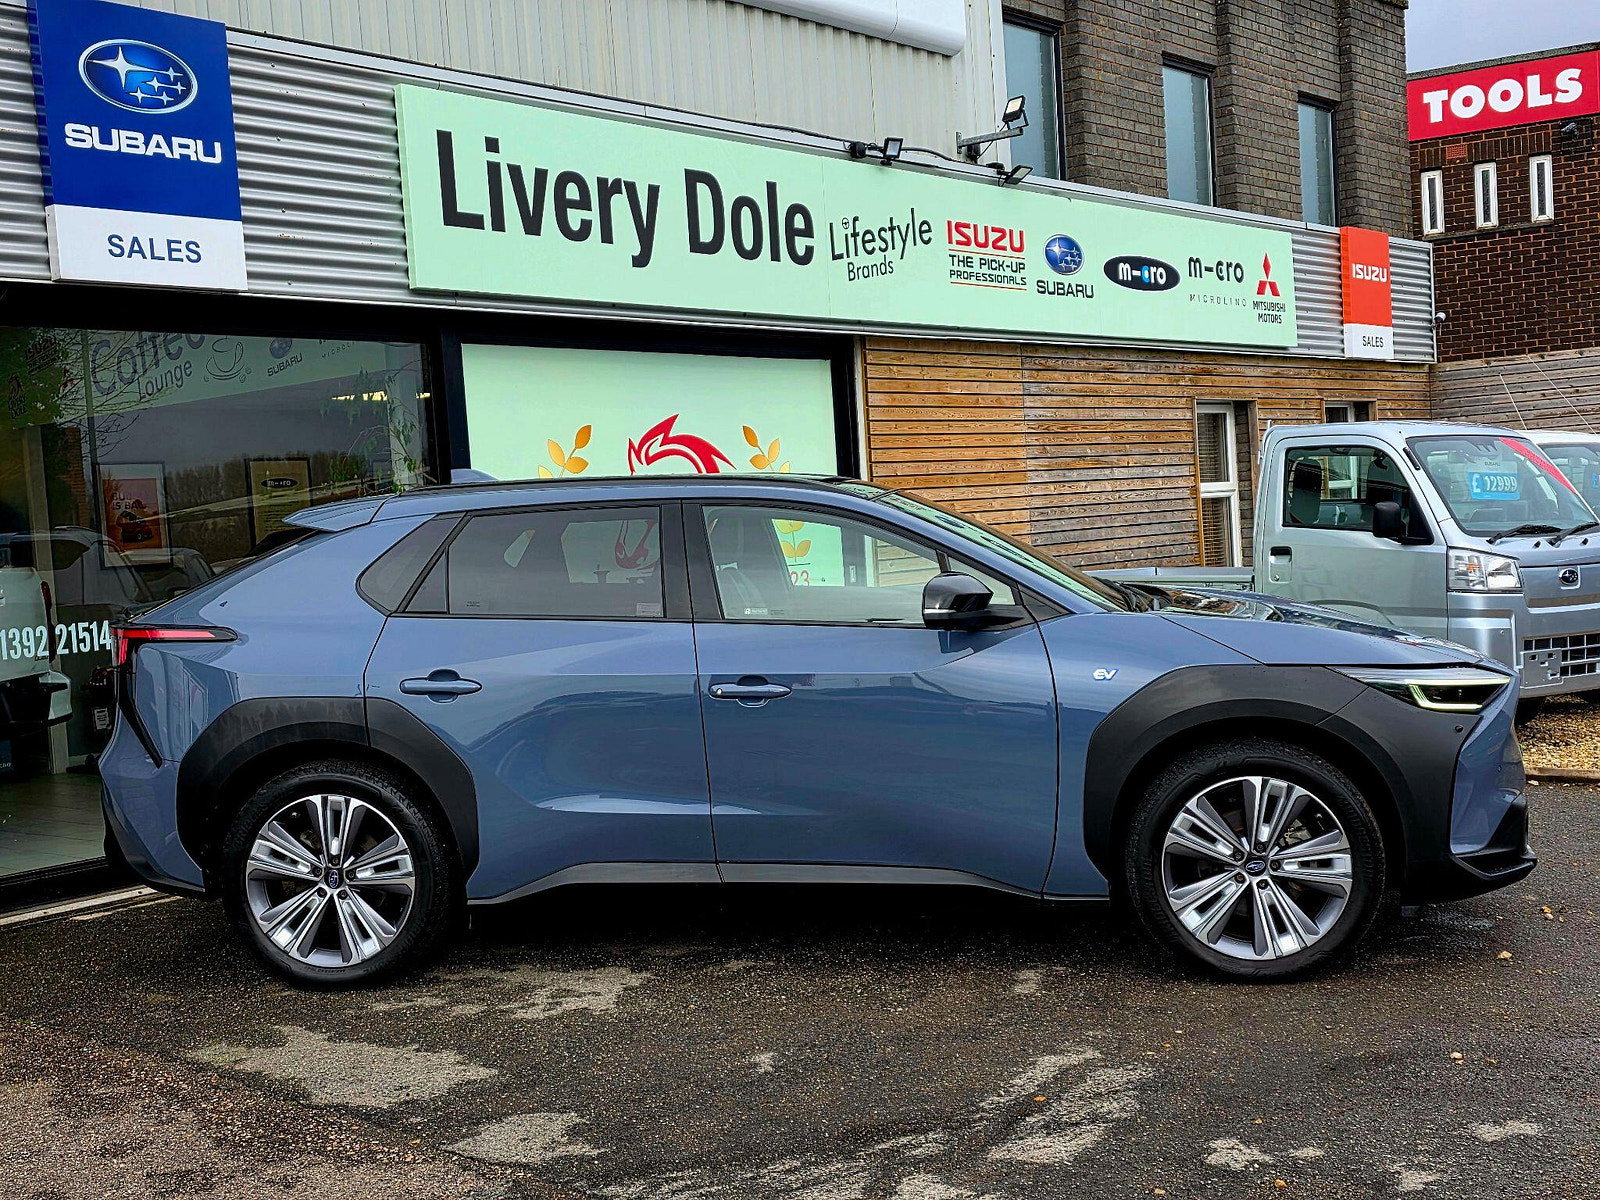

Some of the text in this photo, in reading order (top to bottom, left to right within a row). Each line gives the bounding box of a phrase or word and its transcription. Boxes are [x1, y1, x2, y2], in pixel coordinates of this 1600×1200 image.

[1422, 68, 1583, 123] TOOLS
[64, 122, 223, 164] SUBARU
[436, 129, 815, 269] Livery Dole
[829, 207, 933, 261] Lifestyle
[946, 220, 1025, 253] ISUZU
[107, 233, 202, 264] SALES
[847, 255, 894, 282] Brands
[948, 254, 1026, 274] THE PICK-UP
[1351, 263, 1388, 283] ISUZU
[949, 269, 1027, 286] PROFESSIONALS
[1036, 279, 1094, 299] SUBARU
[1189, 292, 1247, 308] MICROLINO
[1252, 300, 1286, 313] MITSUBISHI
[1257, 312, 1282, 325] MOTORS
[1362, 334, 1384, 349] SALES
[267, 352, 303, 377] SUBARU
[138, 360, 193, 402] Lounge
[1472, 473, 1518, 493] £ 12999
[1093, 668, 1119, 680] EV
